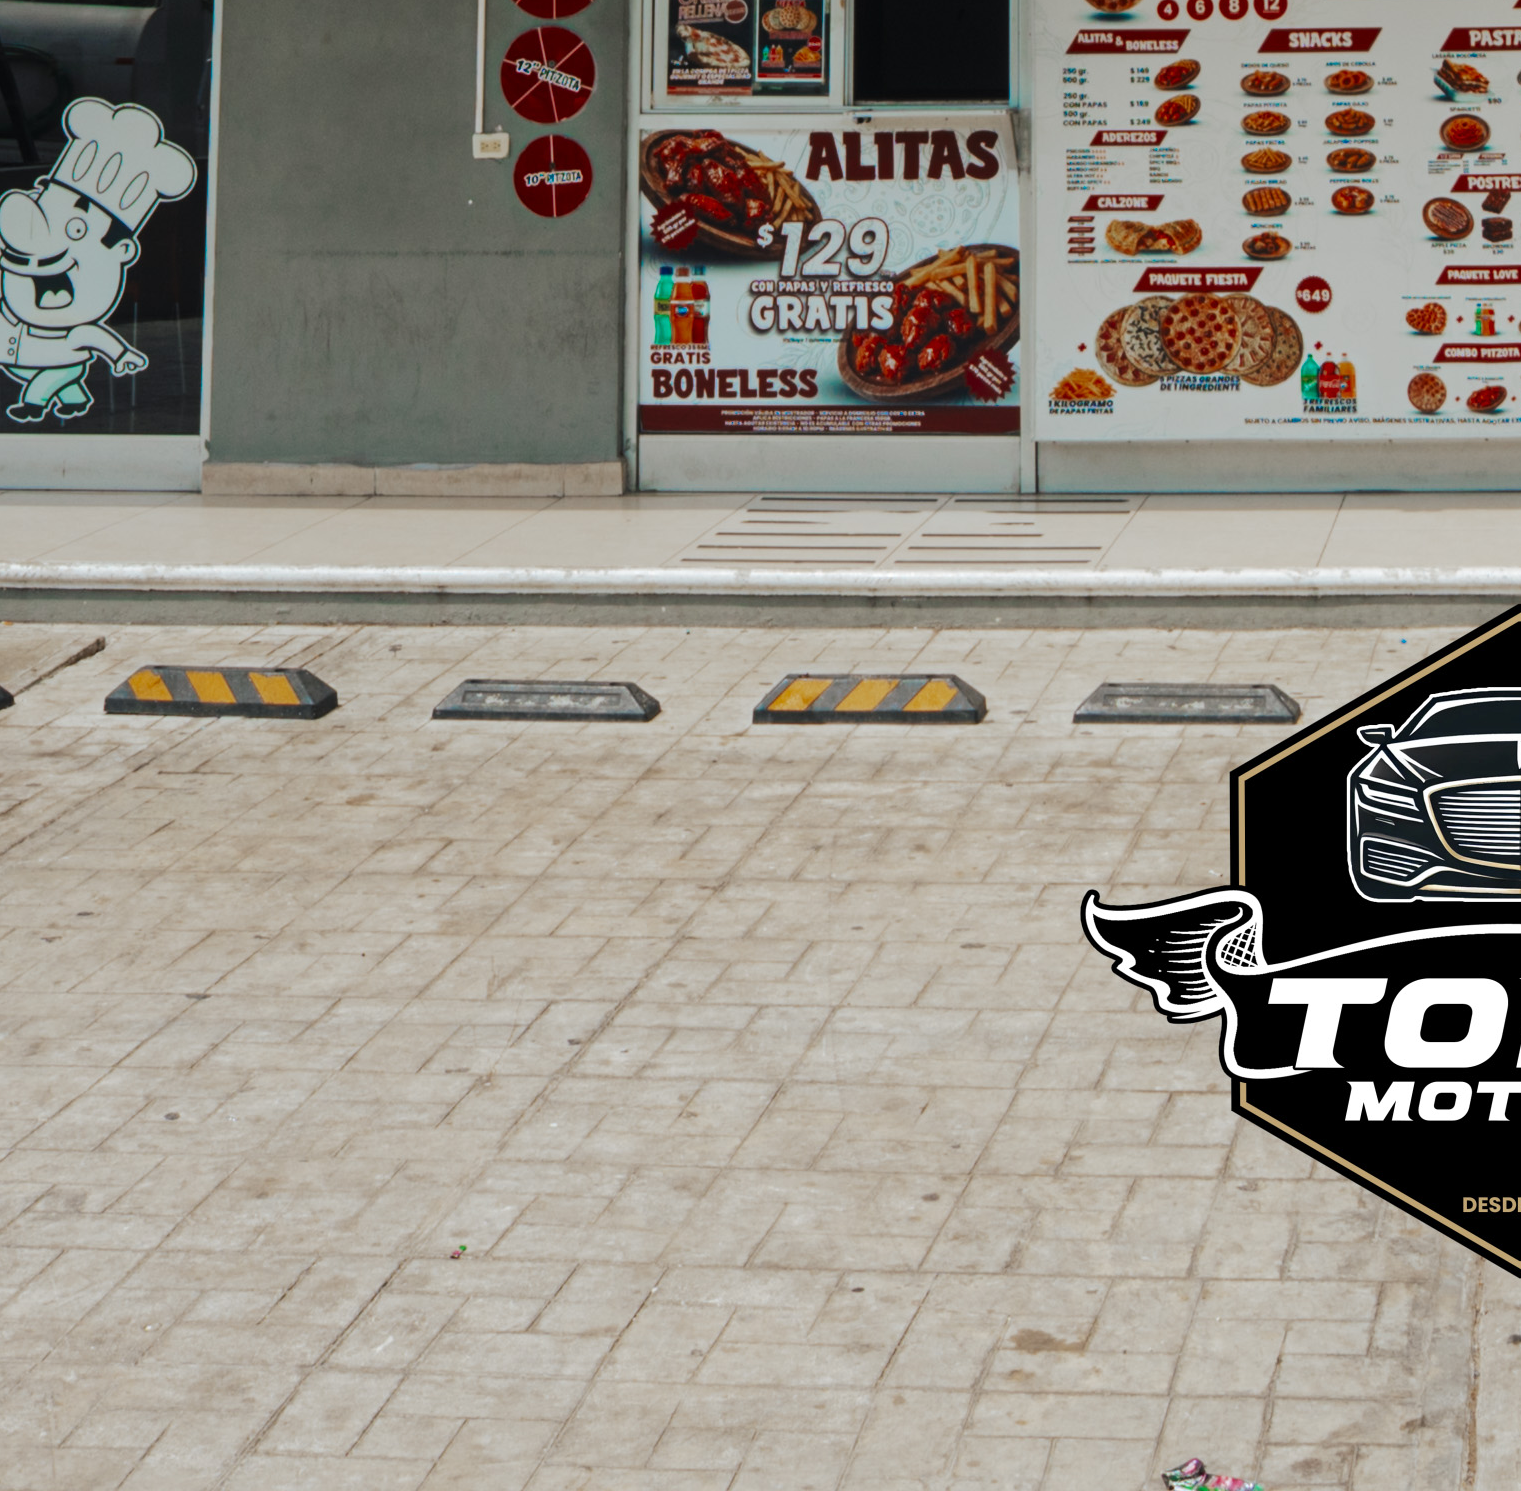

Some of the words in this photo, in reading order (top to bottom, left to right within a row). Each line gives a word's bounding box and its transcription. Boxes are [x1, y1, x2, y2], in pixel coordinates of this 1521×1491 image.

[1288, 31, 1353, 49] SNACKS
[805, 130, 999, 181] ALITAS
[757, 217, 890, 278] $129
[751, 280, 774, 293] CON
[778, 280, 816, 293] PAPAS
[819, 280, 829, 293] Y
[832, 280, 895, 293] REFRESCO
[1149, 273, 1202, 286] PAQUETE
[1205, 272, 1248, 286] FIESTA
[1296, 289, 1330, 302] $649
[750, 294, 895, 332] GRATIS
[650, 352, 712, 365] GRATIS
[651, 368, 819, 399] BONELESS
